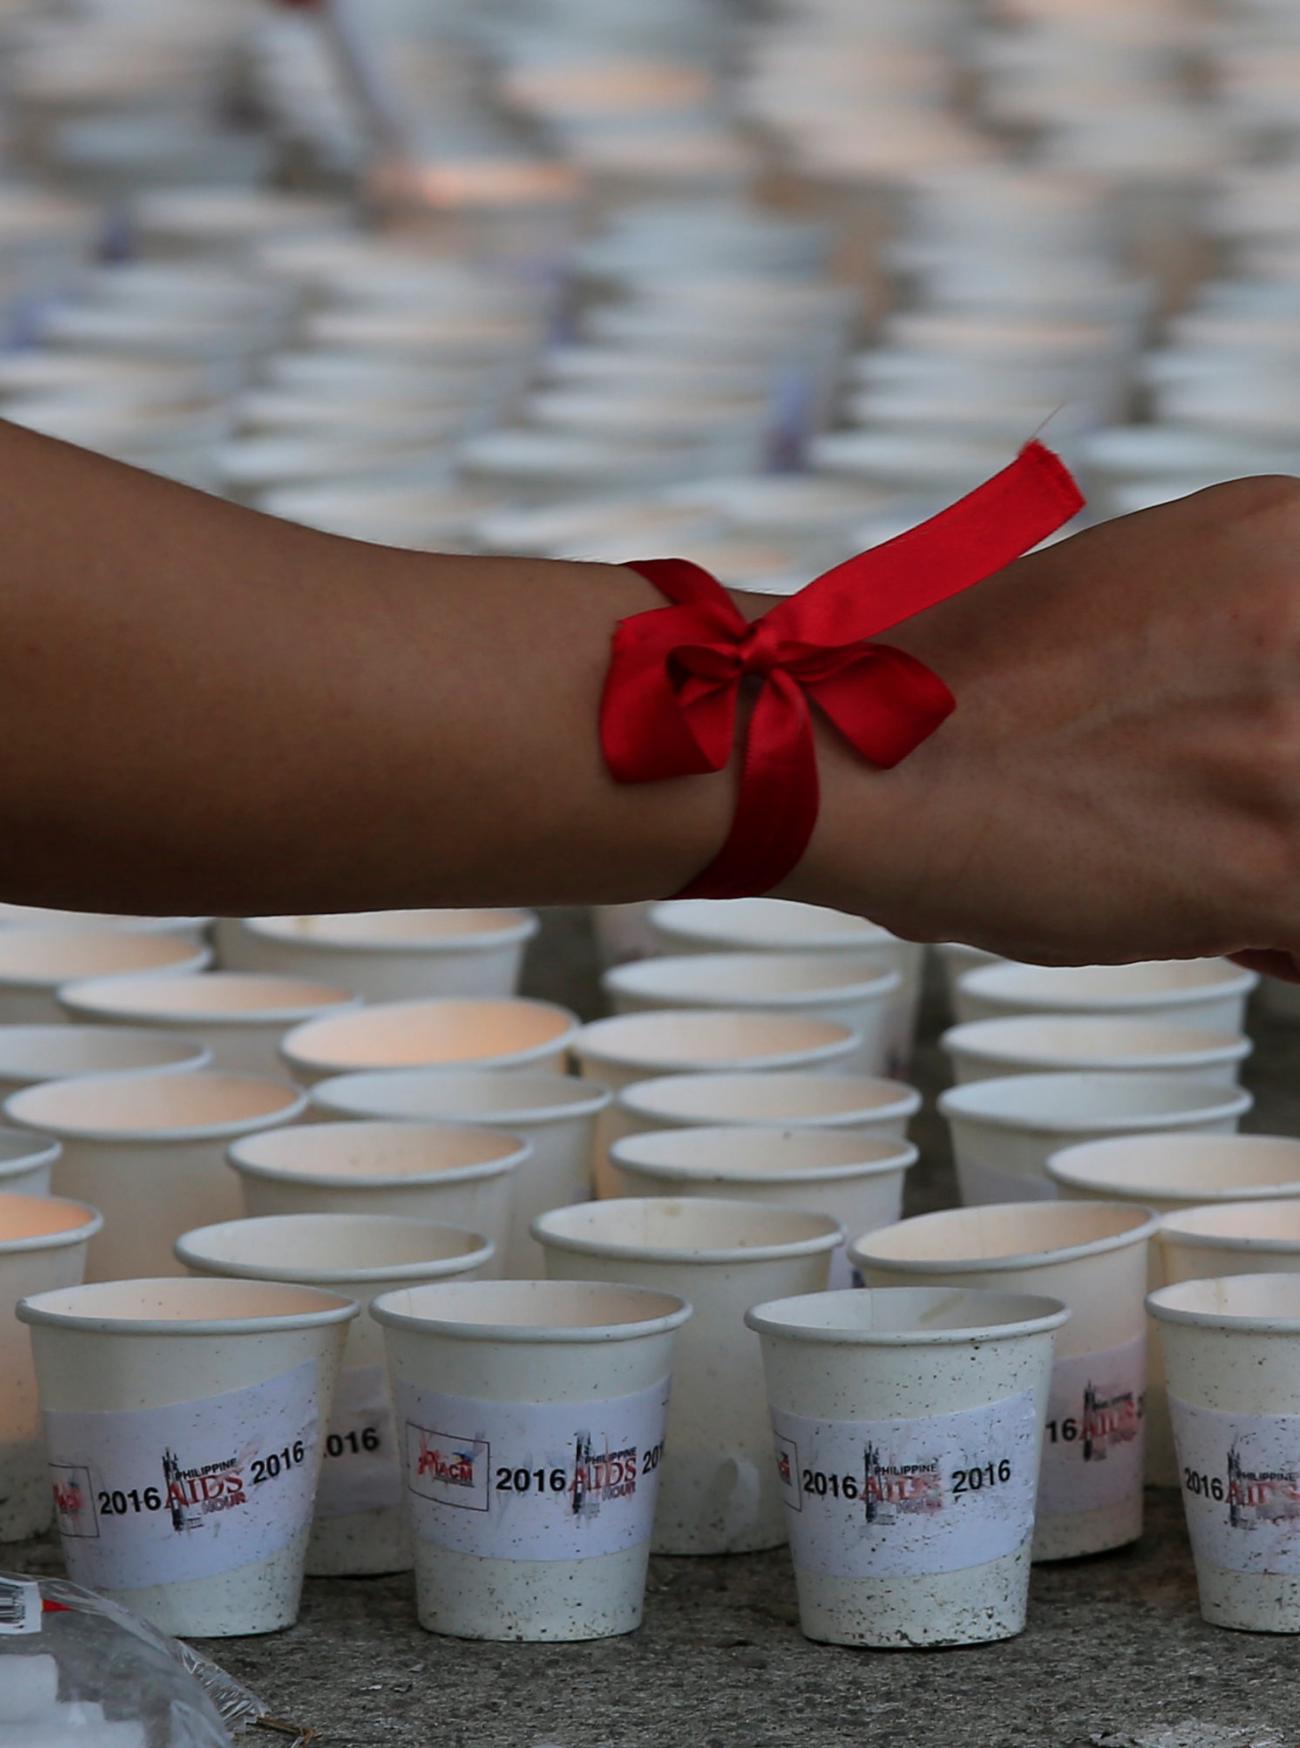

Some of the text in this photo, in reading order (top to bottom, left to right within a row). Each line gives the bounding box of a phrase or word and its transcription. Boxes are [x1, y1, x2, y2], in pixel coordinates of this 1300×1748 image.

[323, 1427, 380, 1458] 016
[250, 1440, 305, 1485] 2016
[567, 1459, 638, 1494] AIDS
[874, 1462, 937, 1477] PHILIPPINE
[951, 1459, 1011, 1494] 2016
[164, 1474, 244, 1510] AIDS
[495, 1467, 567, 1493] 2016
[802, 1469, 859, 1499] 2016
[1184, 1466, 1225, 1501] 2016
[98, 1486, 162, 1516] 2016
